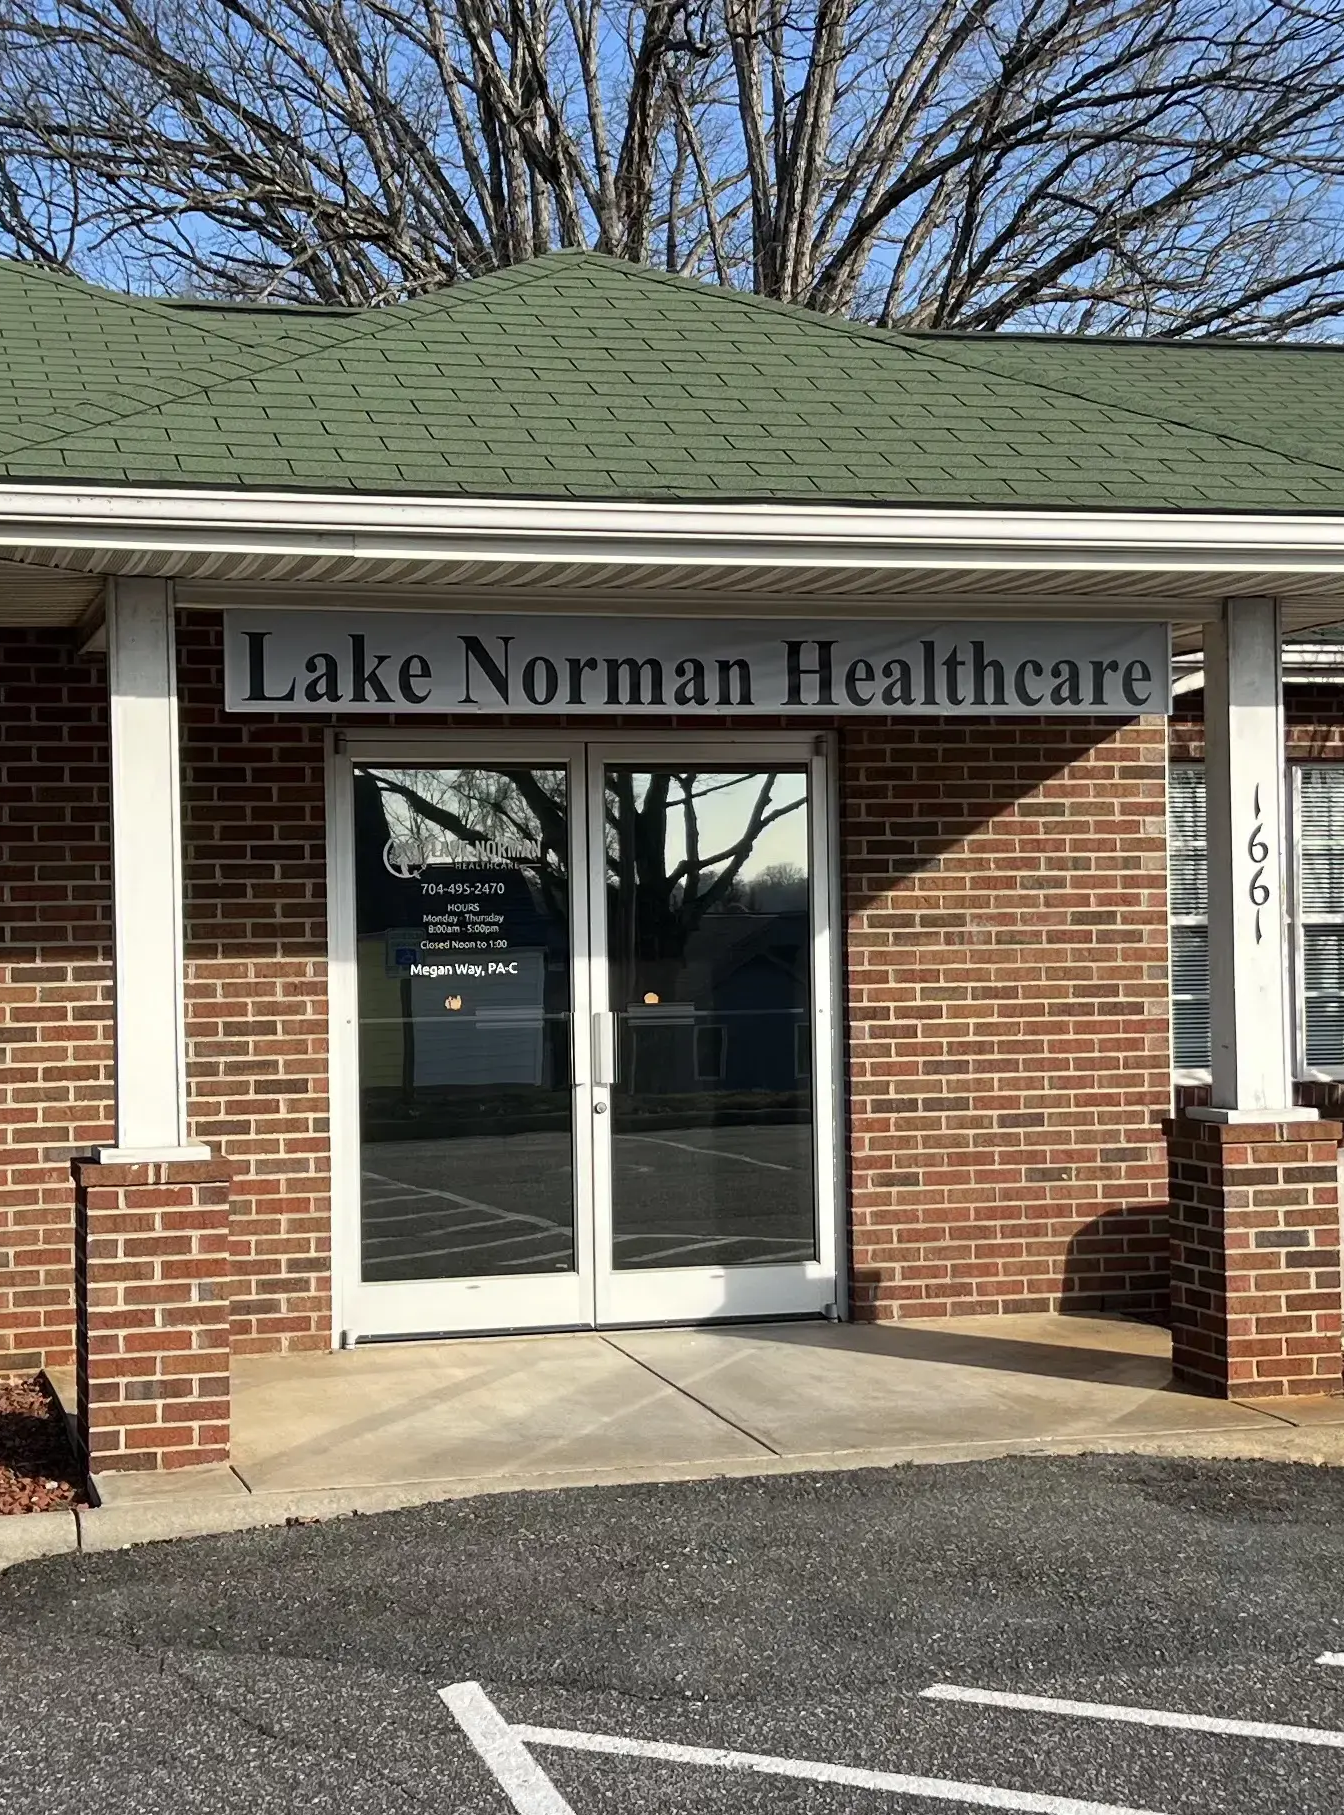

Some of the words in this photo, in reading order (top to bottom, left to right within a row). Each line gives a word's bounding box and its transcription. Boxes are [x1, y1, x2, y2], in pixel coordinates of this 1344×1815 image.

[240, 632, 433, 704] Lake
[457, 636, 755, 706] Norman
[780, 640, 1152, 707] Healthcare
[475, 840, 541, 858] NORMAN
[455, 862, 520, 870] HEALTHCARE
[1248, 782, 1270, 945] 1661
[420, 883, 505, 895] 704-495-2470
[447, 903, 480, 912] HOURS
[422, 914, 458, 924] Monday
[464, 913, 505, 923] Thursday
[428, 925, 460, 933] 8:00am
[466, 925, 499, 934] 5:00pm
[420, 940, 450, 949] Closed
[451, 940, 476, 949] Noon
[476, 940, 487, 949] to
[489, 939, 508, 949] 1:00
[410, 963, 453, 978] Megan
[455, 963, 485, 977] Way,
[488, 962, 518, 975] PA-C
